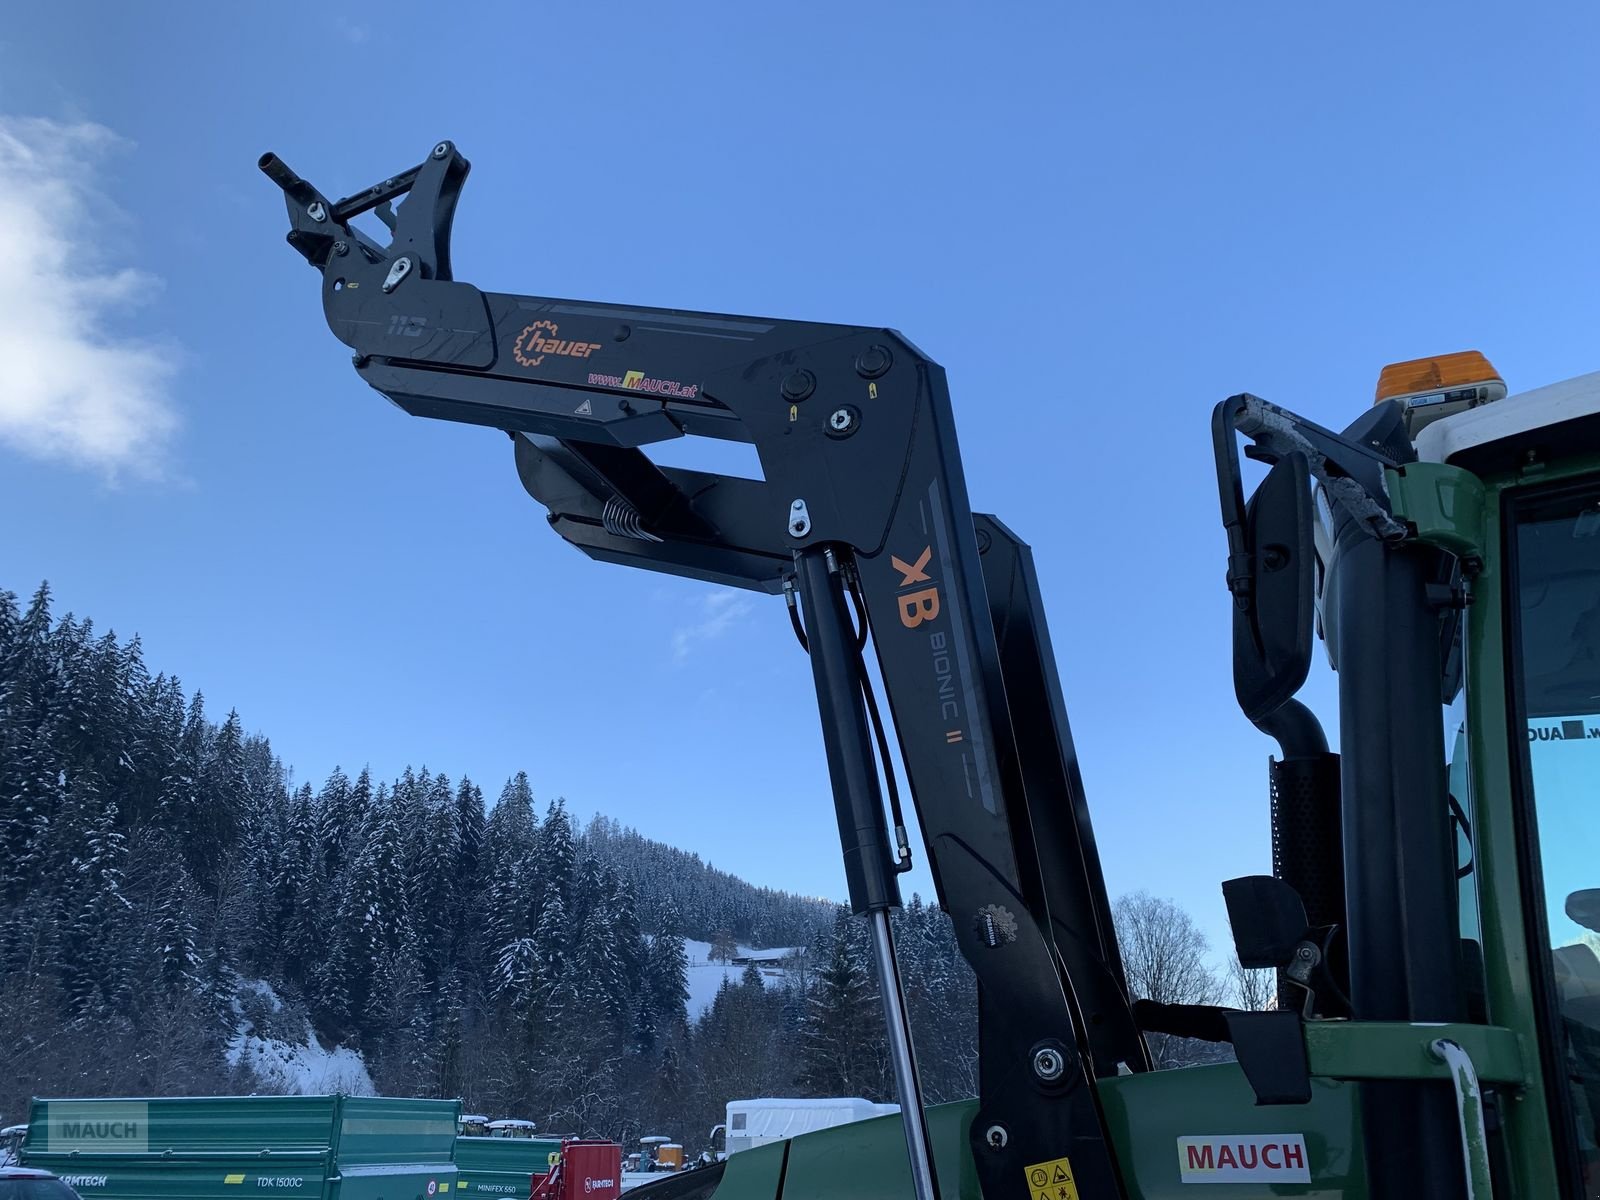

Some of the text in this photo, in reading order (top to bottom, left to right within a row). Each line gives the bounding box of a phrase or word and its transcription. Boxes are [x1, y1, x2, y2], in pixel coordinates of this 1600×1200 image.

[526, 331, 602, 358] hauer
[587, 372, 698, 398] www.MAUCH.at
[930, 631, 963, 743] BIONIC II
[1186, 1144, 1304, 1169] MAUCH
[257, 1177, 274, 1187] TDK
[477, 1184, 504, 1193] MINIFEX
